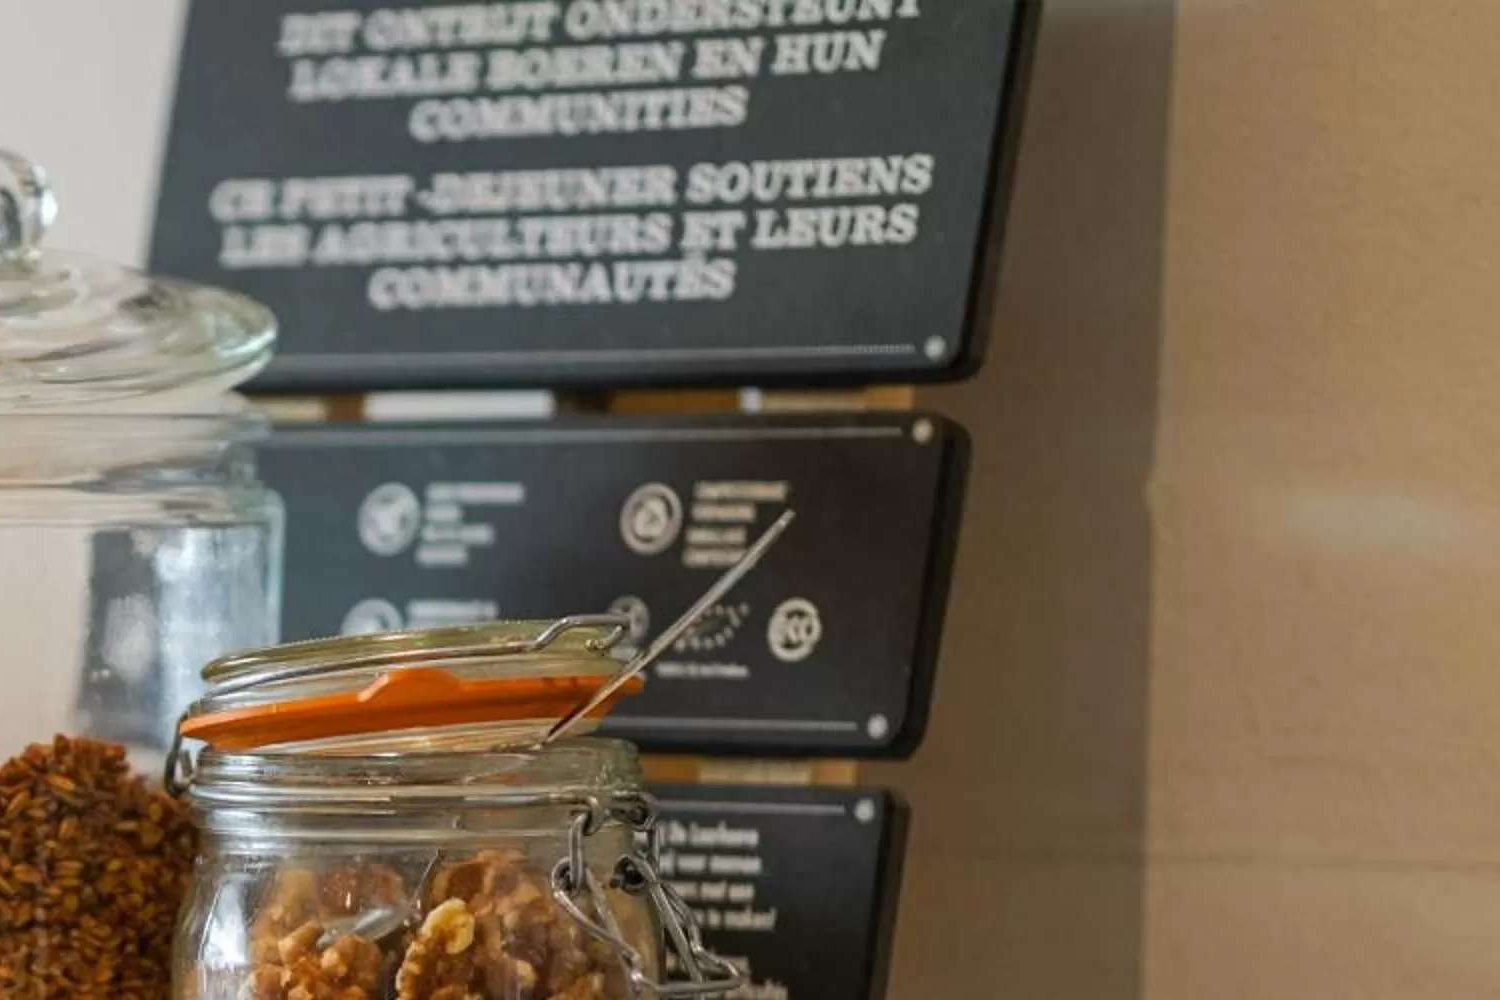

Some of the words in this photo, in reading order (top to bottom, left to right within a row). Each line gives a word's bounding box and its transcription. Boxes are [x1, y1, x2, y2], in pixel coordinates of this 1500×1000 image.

[288, 53, 480, 101] LOKALE
[486, 41, 685, 90] BOEREN
[691, 36, 765, 79] EN
[771, 29, 886, 76] HUN
[409, 84, 748, 142] COMMUNITIES
[687, 153, 934, 203] SOUTIENS
[218, 223, 306, 269] LES
[311, 212, 673, 266] AGRICULTEURS
[681, 209, 747, 250] ET
[750, 203, 919, 248] LEURS
